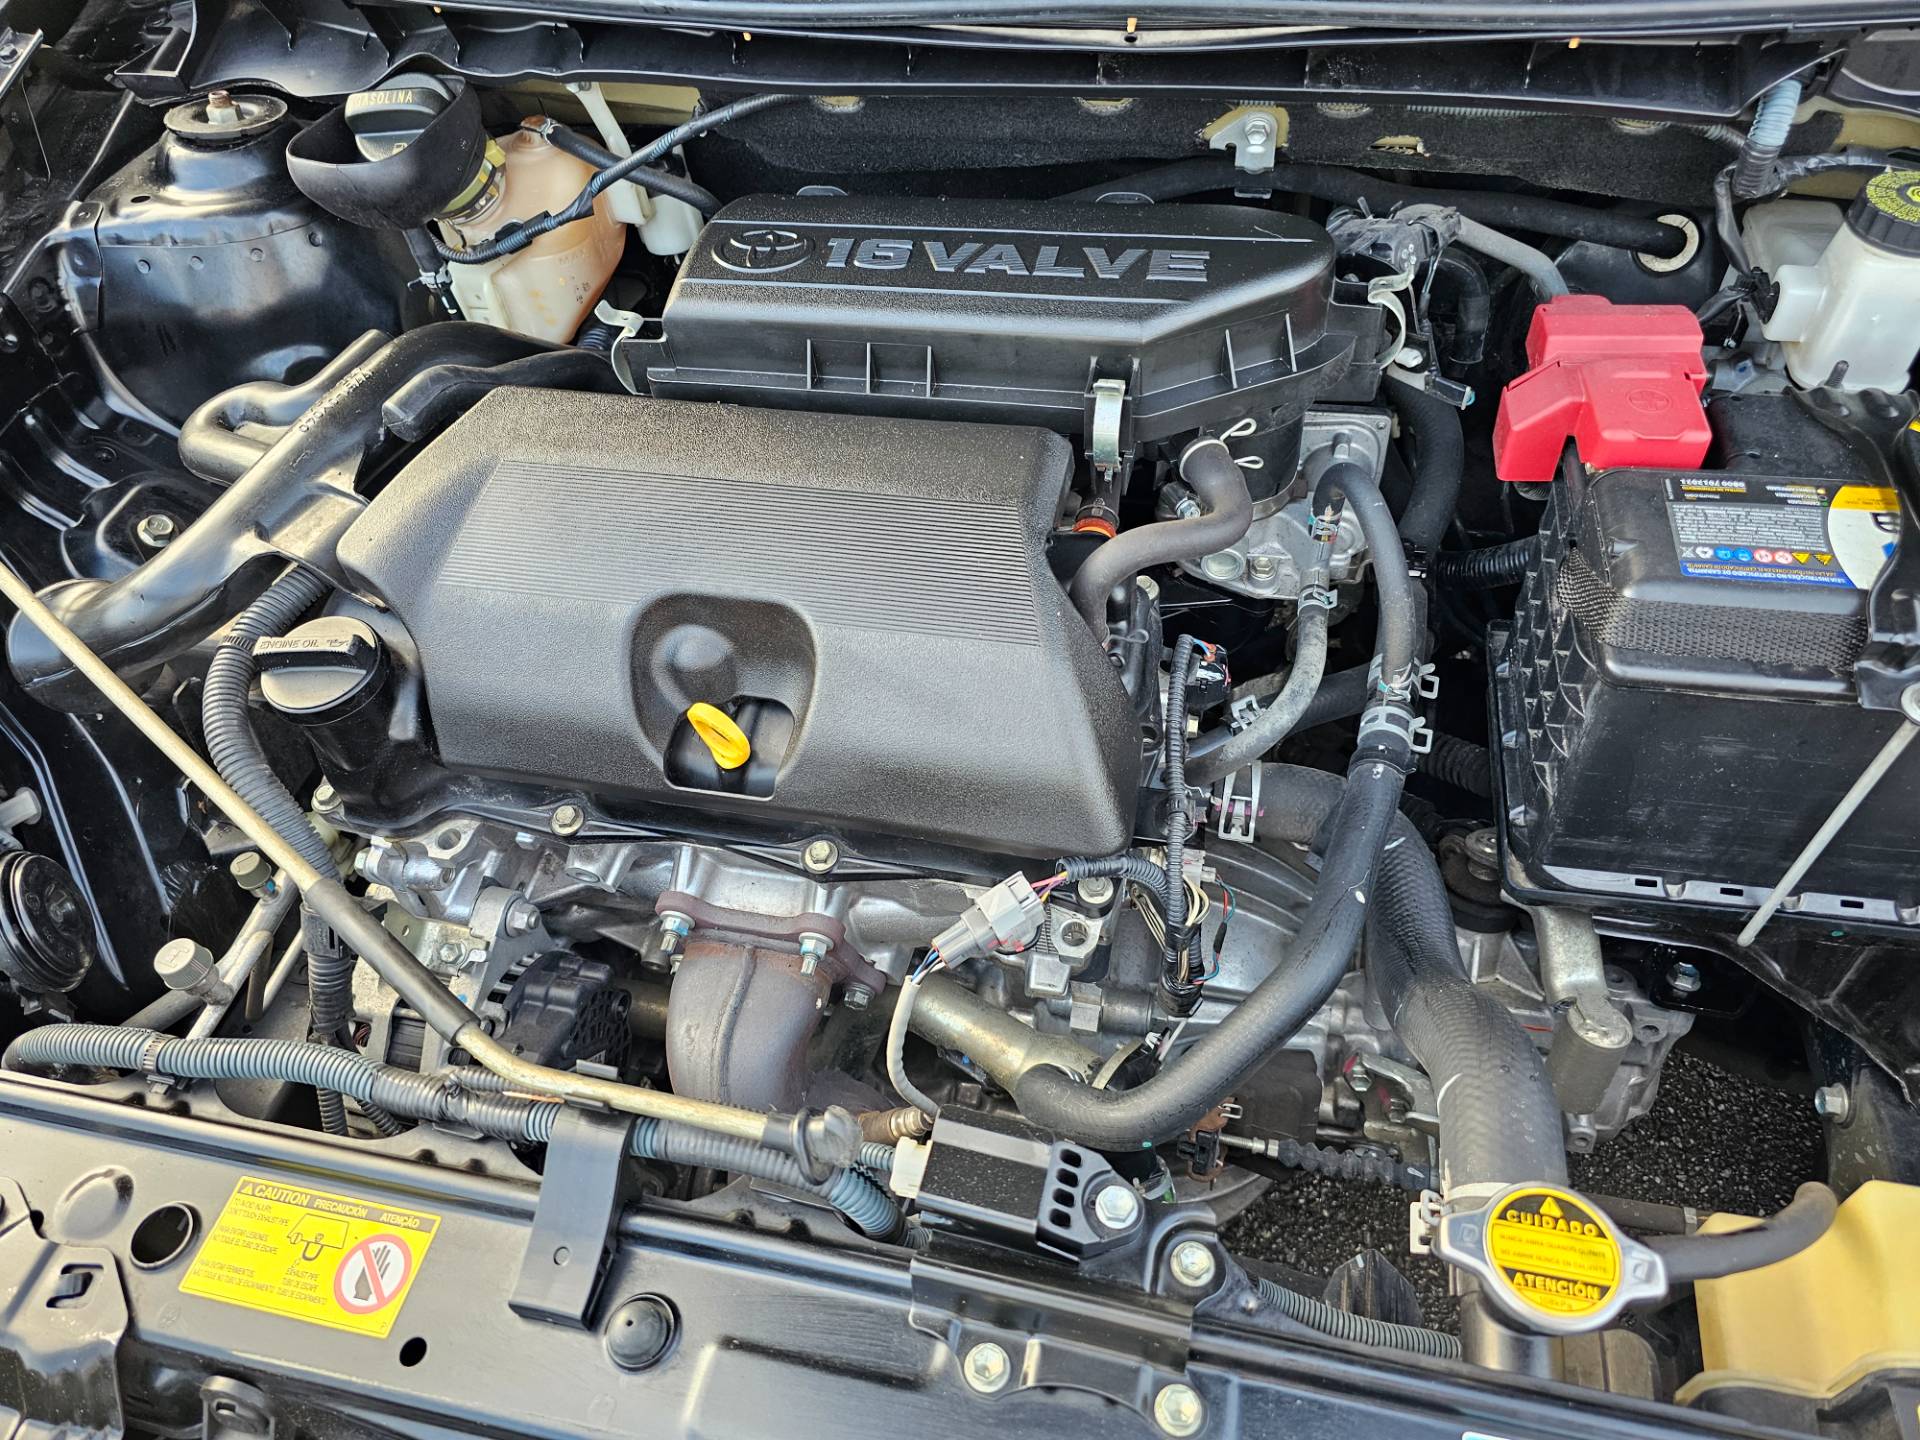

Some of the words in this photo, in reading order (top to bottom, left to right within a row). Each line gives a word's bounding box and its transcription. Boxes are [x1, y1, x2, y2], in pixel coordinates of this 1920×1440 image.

[822, 238, 913, 270] 16
[923, 241, 1211, 282] VALVE
[1732, 570, 1776, 579] CERTIFICADO
[259, 639, 300, 649] ENGINE
[302, 639, 320, 648] OIL
[253, 1184, 311, 1207] CAUTION
[313, 1198, 369, 1219] PRECAUCIÓN
[379, 1211, 421, 1229] ATENÇÃO
[1505, 1209, 1600, 1237] CUIDADO
[1512, 1271, 1600, 1300] ATENCIÓN
